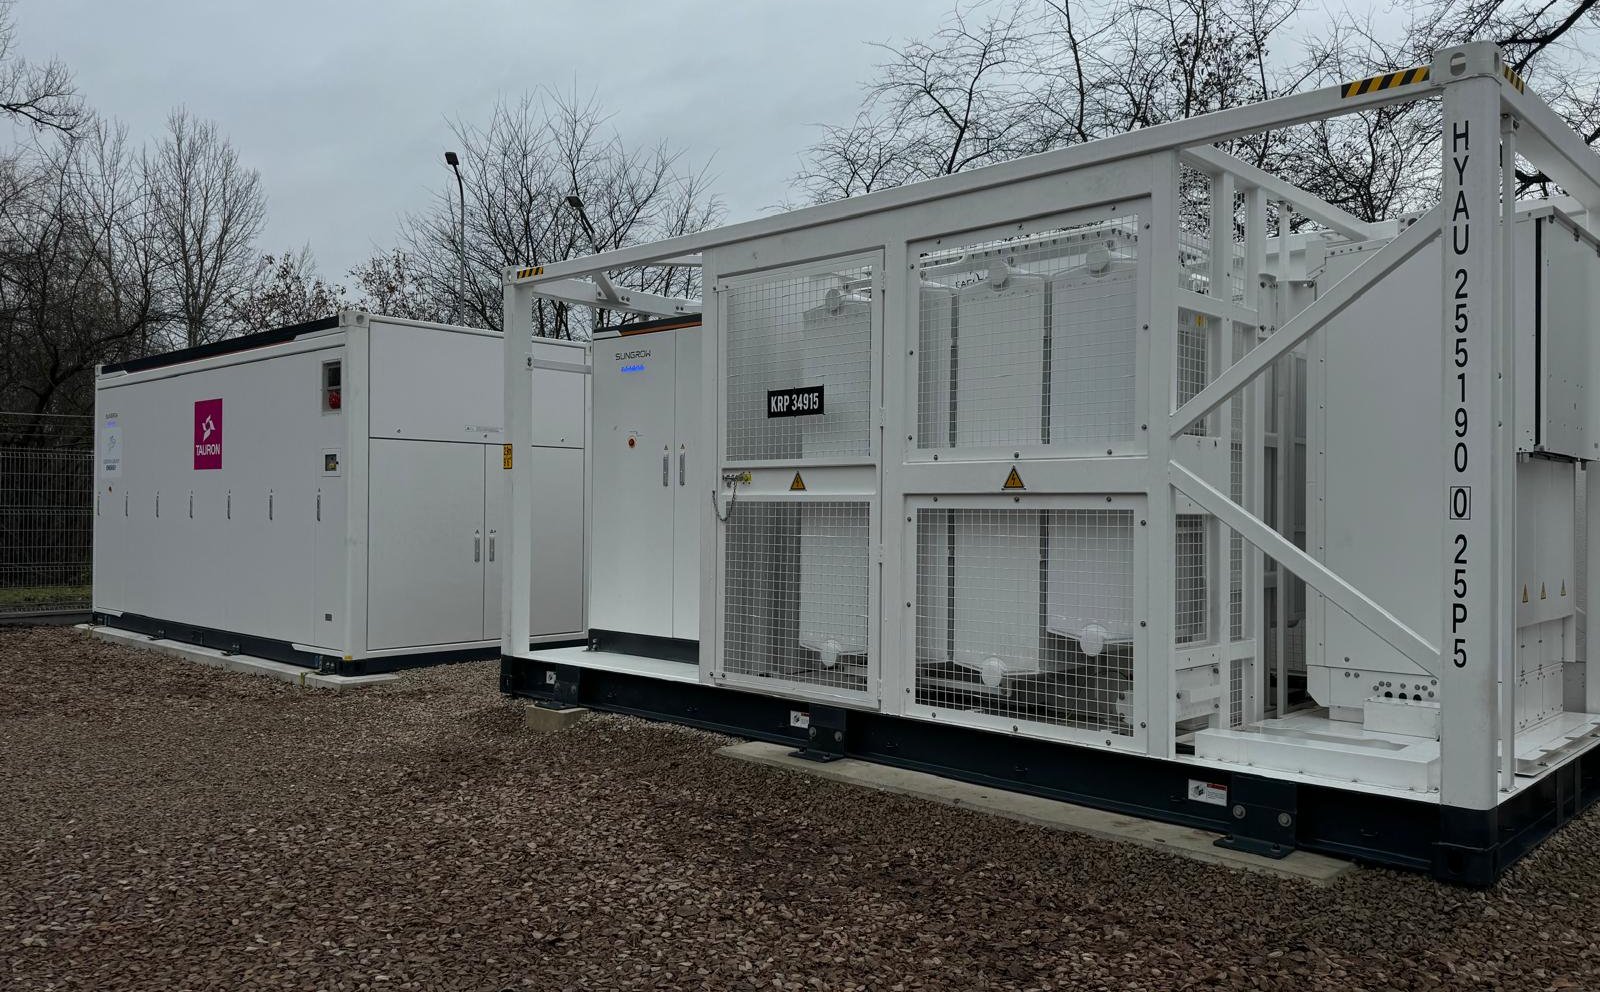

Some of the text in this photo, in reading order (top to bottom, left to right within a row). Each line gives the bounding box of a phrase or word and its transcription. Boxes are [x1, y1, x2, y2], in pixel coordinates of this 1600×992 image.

[615, 350, 652, 361] SUNGROW
[771, 392, 819, 412] KRP 34915
[1452, 119, 1470, 669] HYAU 255190 0 25P5
[195, 444, 221, 456] TAURON
